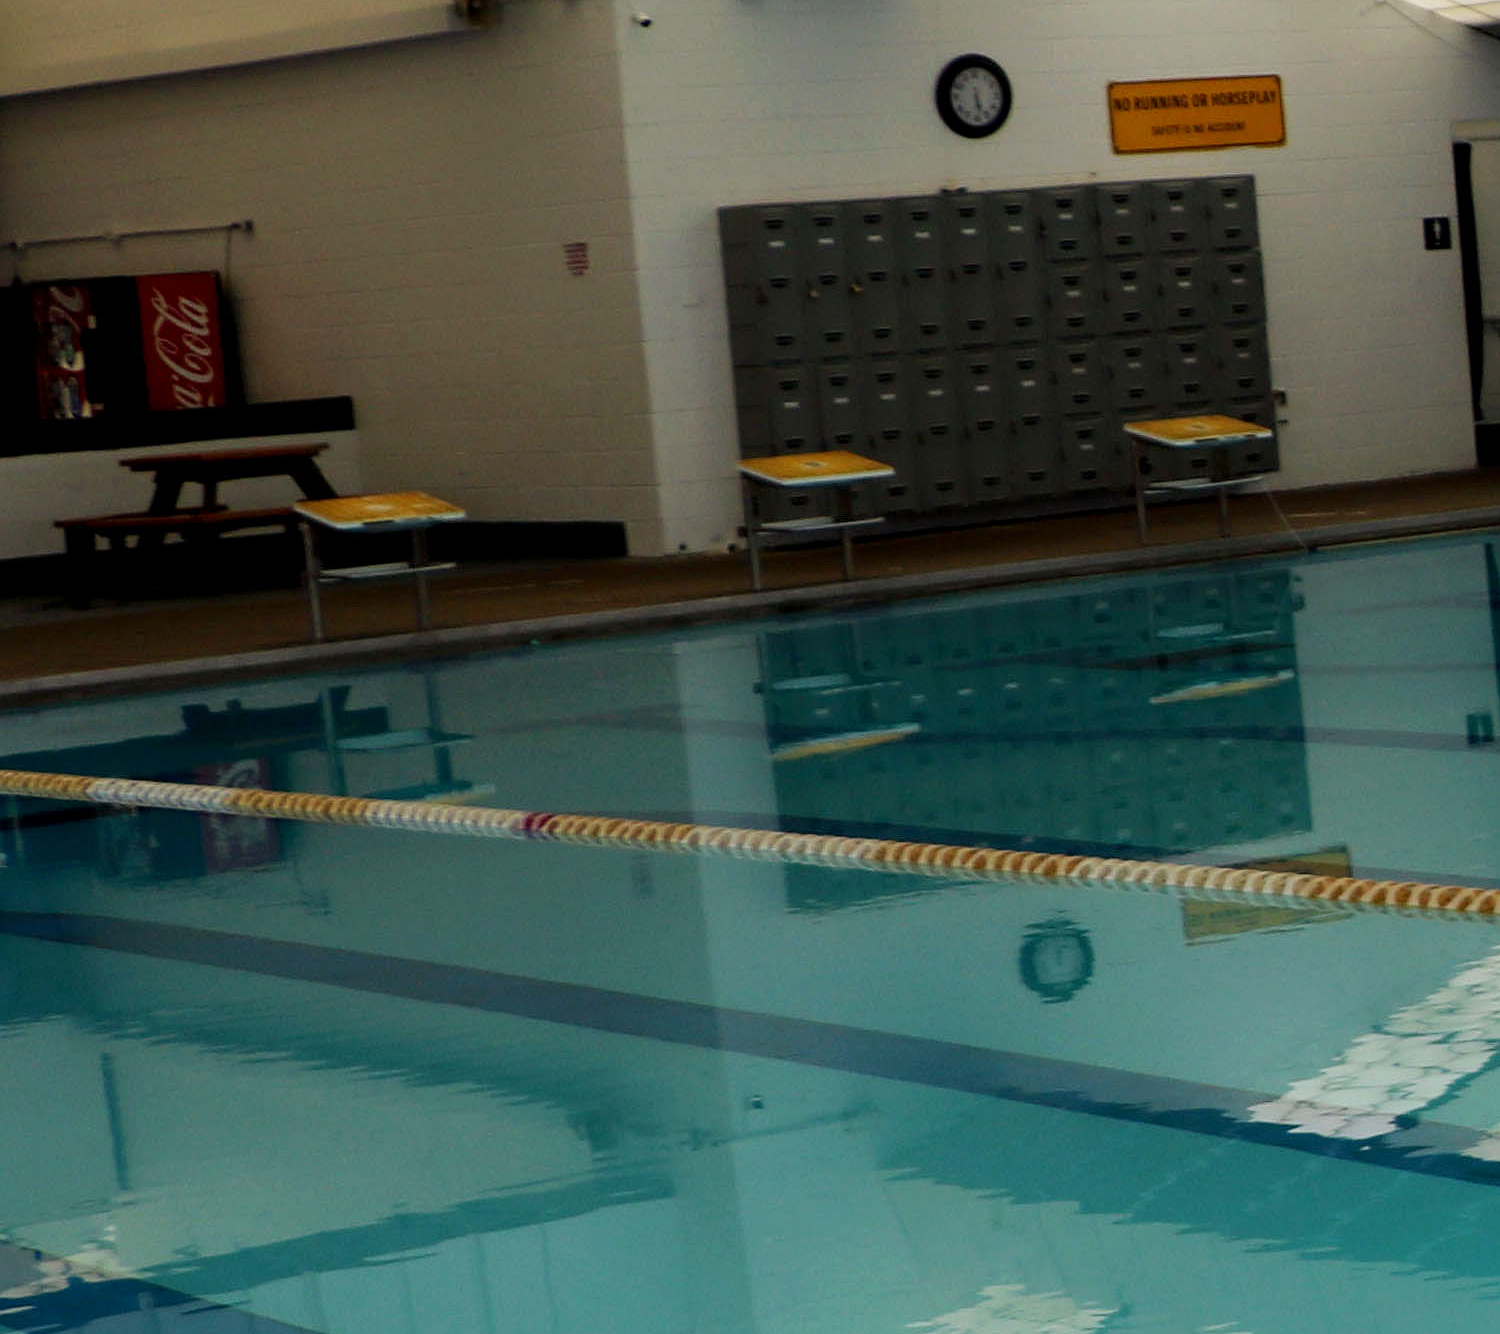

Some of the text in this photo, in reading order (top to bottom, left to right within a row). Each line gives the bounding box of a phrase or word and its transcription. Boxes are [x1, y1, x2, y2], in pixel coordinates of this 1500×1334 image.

[1113, 90, 1276, 111] NO RUNNING OR HORSEPLAY
[149, 286, 215, 411] a-Cola
